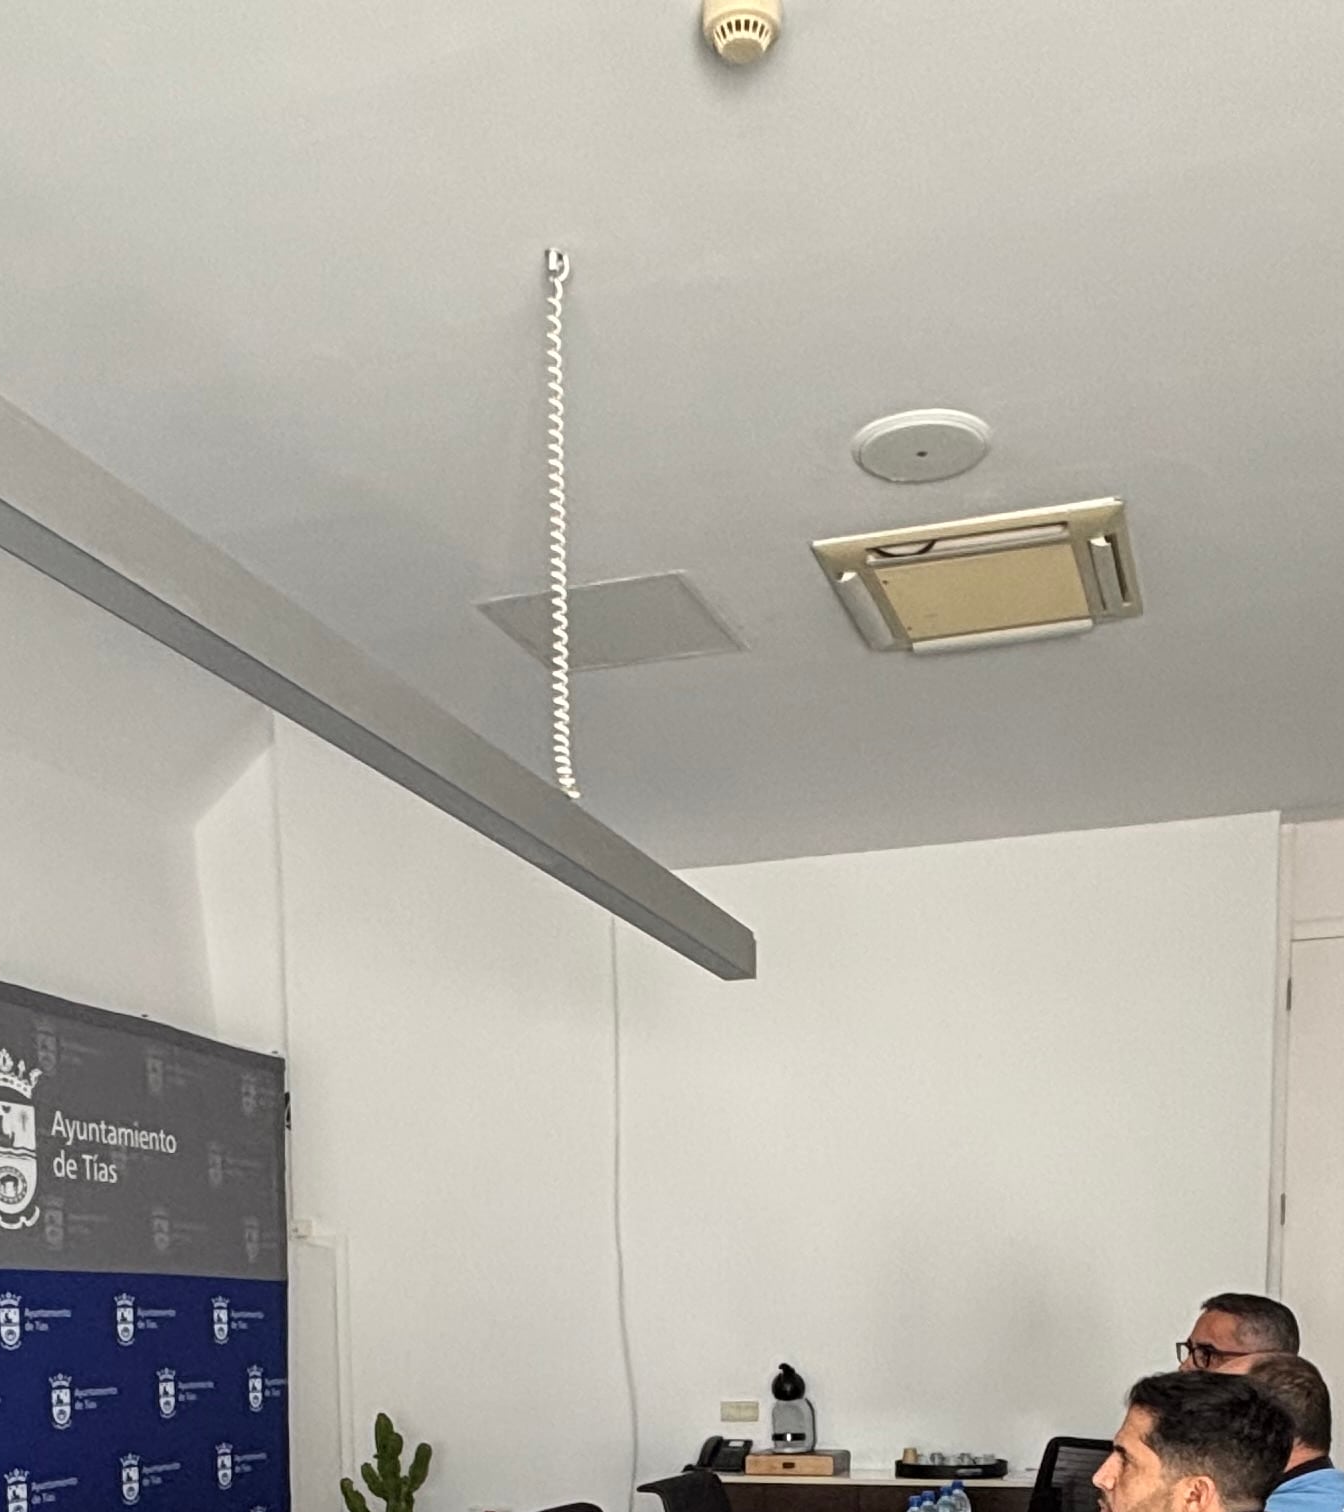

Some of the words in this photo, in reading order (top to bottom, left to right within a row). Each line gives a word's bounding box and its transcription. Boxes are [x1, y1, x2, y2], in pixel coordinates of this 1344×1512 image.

[51, 1110, 177, 1153] Ayuntamiento
[53, 1149, 77, 1179] de
[81, 1153, 118, 1183] Tías
